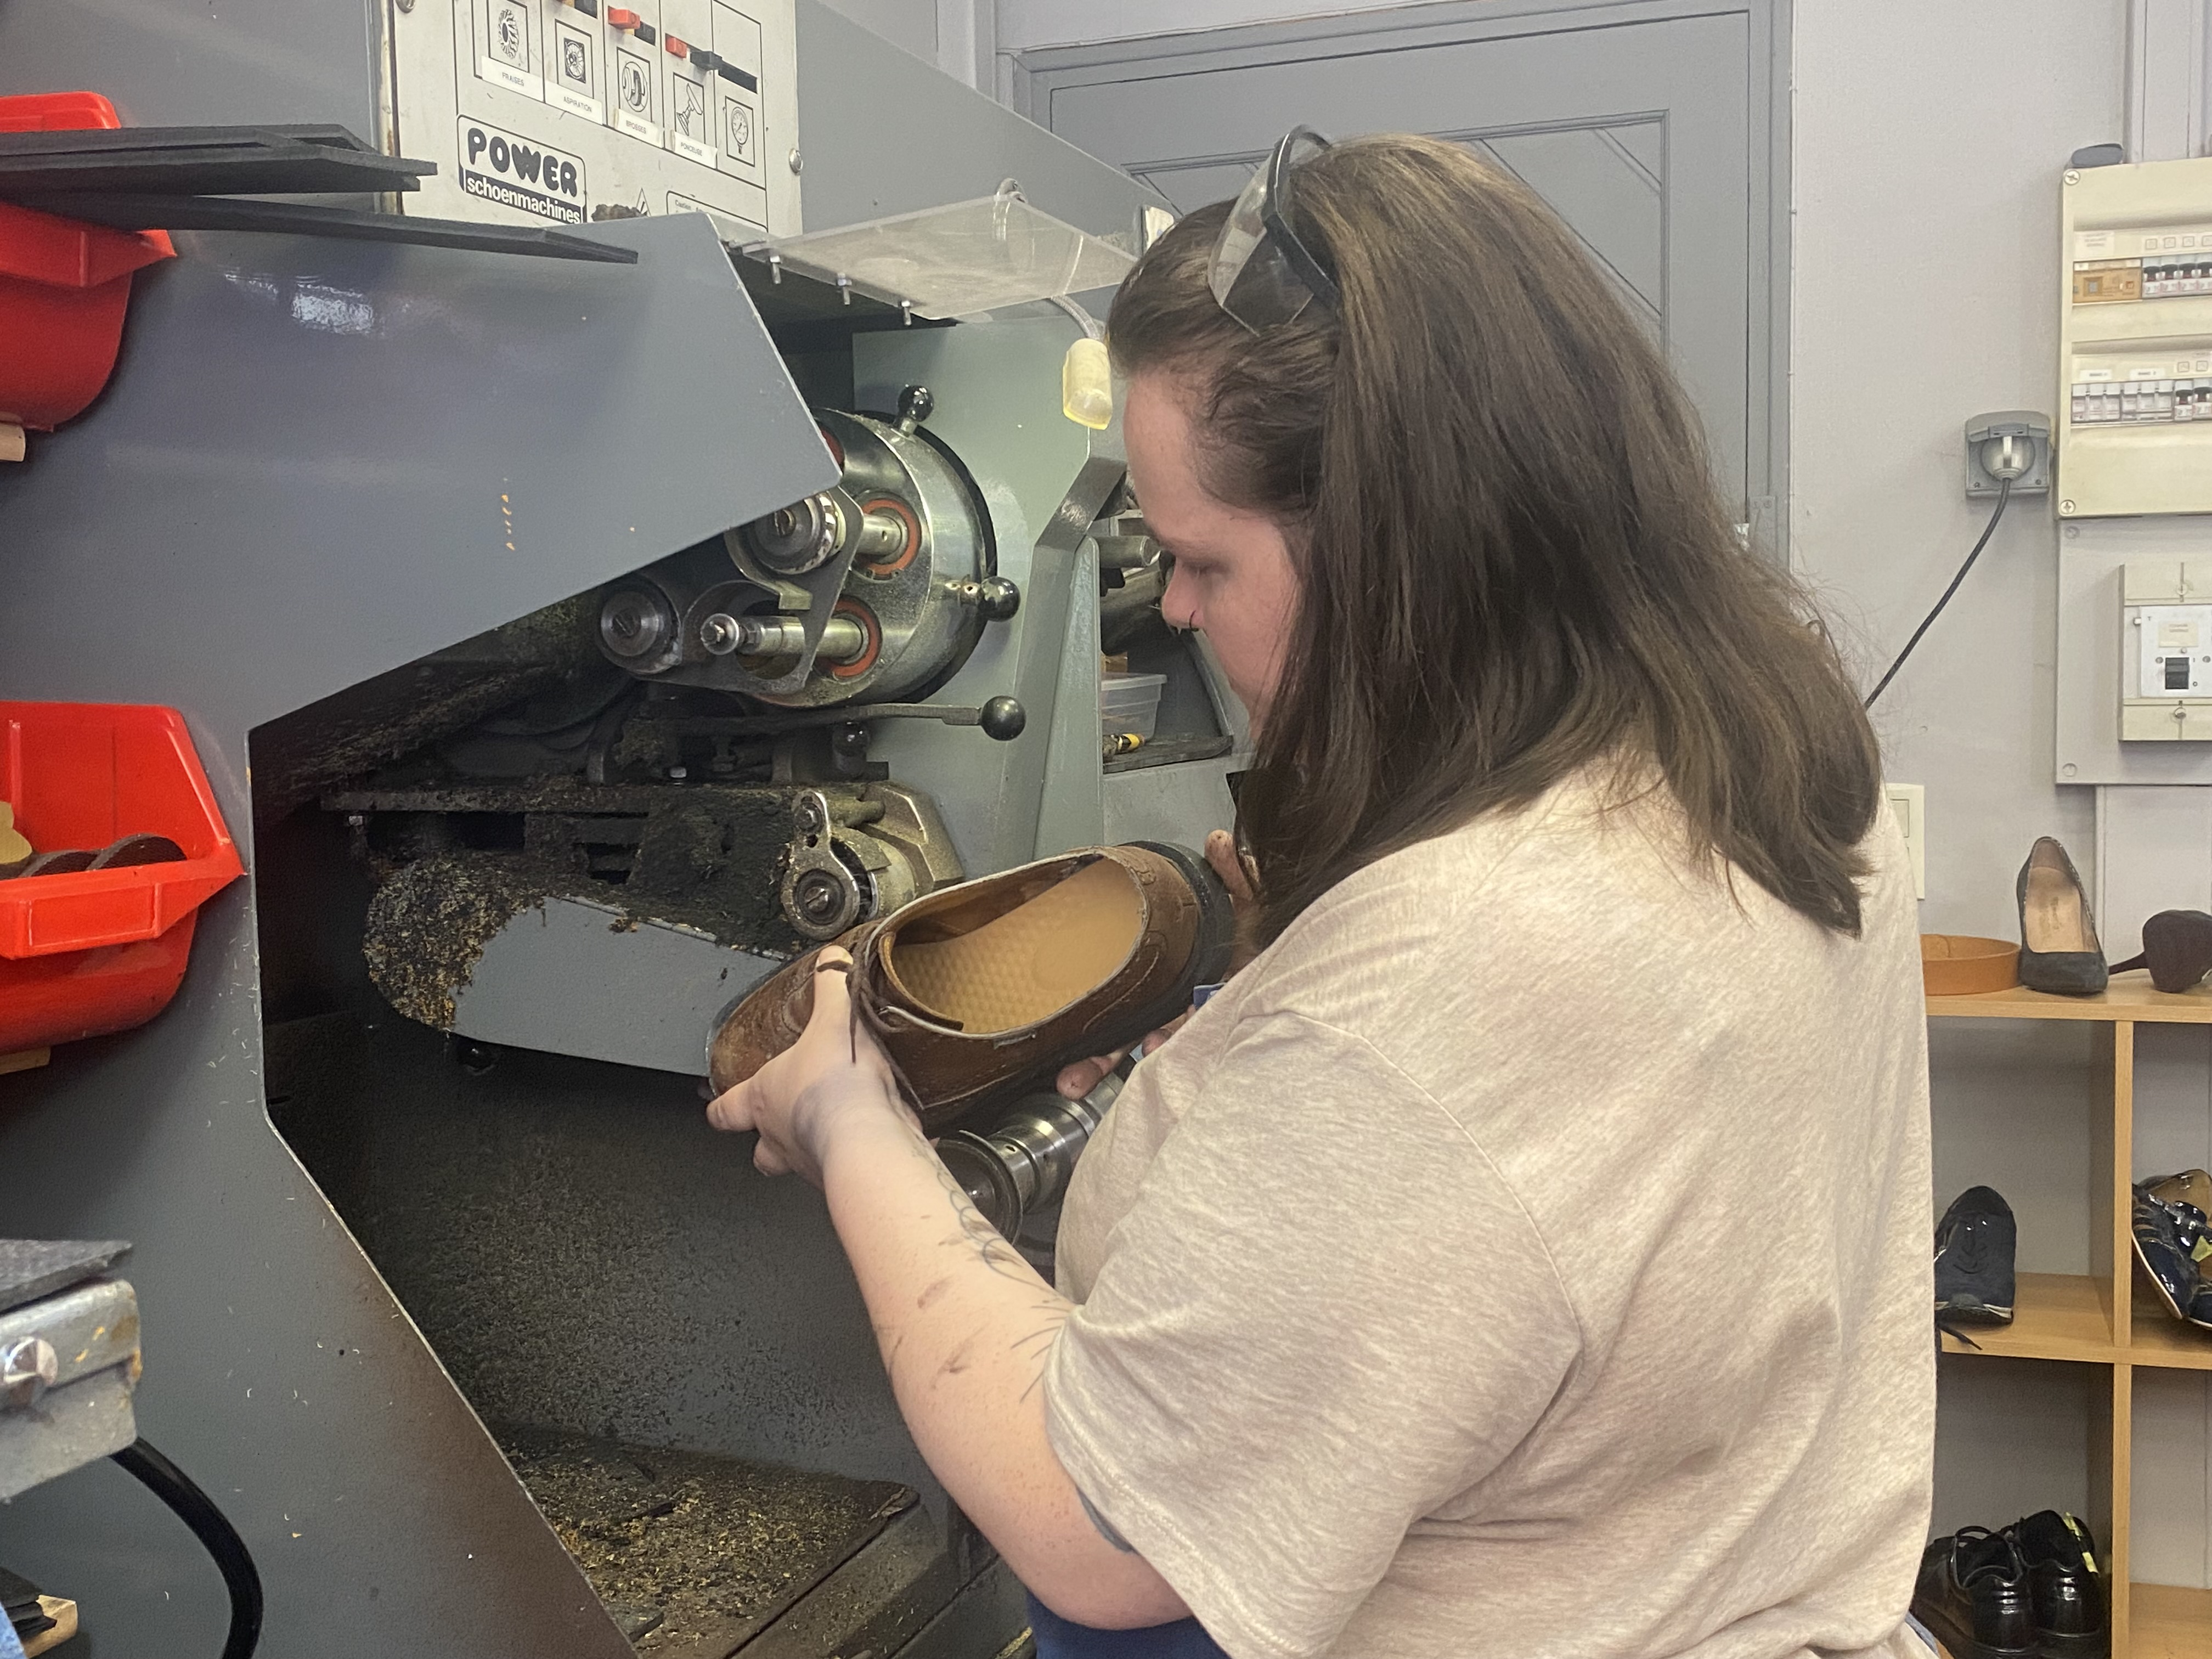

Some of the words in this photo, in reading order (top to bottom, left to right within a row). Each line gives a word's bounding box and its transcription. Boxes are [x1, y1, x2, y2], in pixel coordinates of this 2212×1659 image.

[502, 72, 524, 86] FRAISES
[563, 96, 592, 112] ASPIRATION
[625, 120, 647, 134] BROSSES
[467, 127, 577, 198] POWER
[467, 177, 580, 224] schoenmachines
